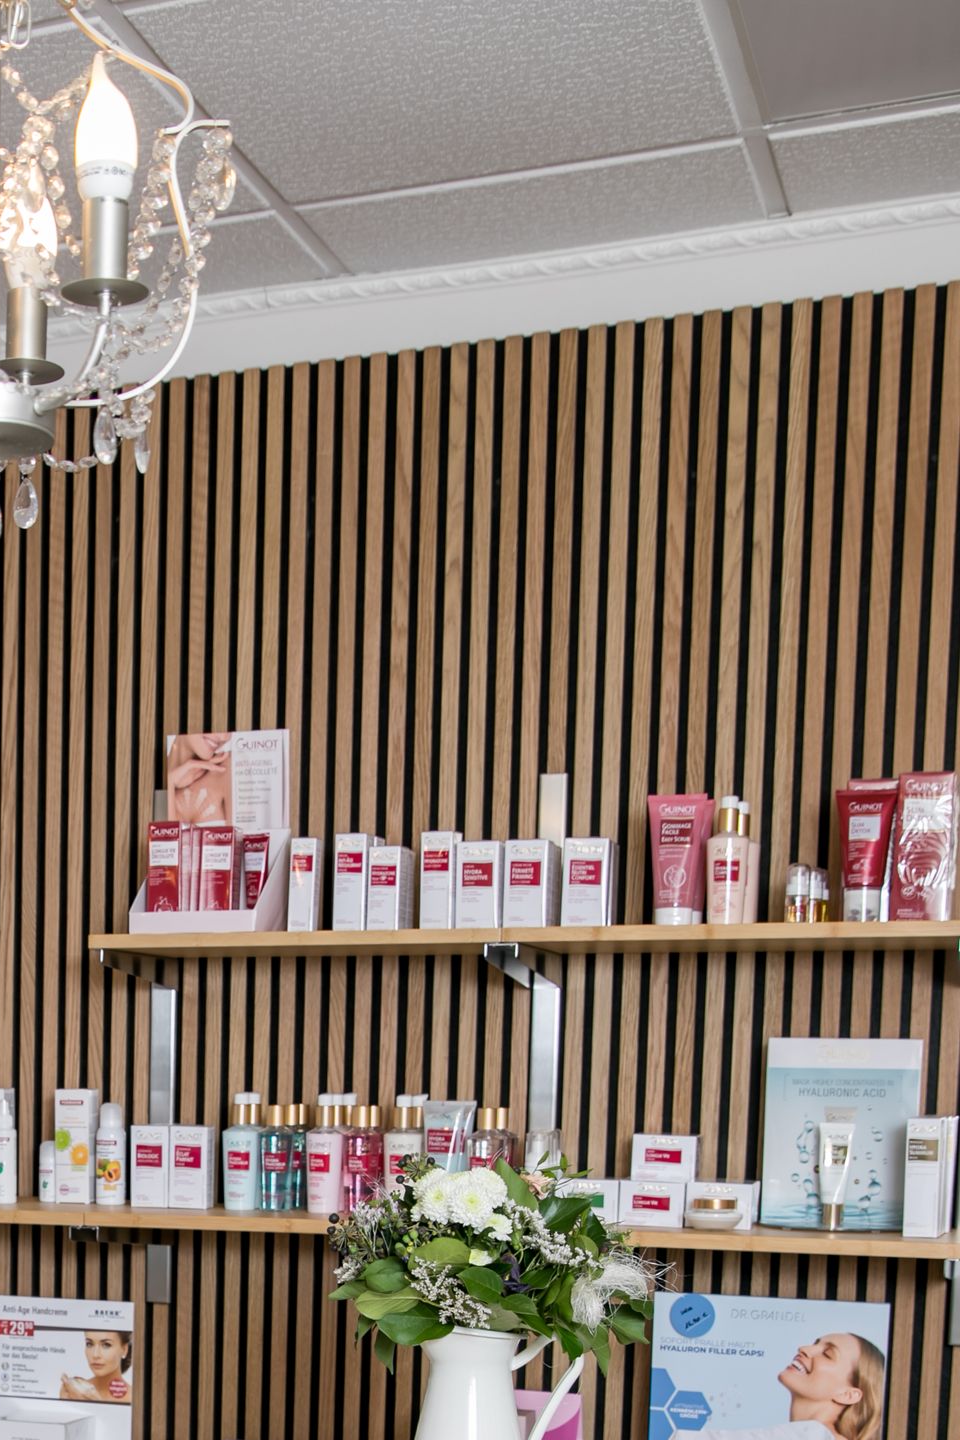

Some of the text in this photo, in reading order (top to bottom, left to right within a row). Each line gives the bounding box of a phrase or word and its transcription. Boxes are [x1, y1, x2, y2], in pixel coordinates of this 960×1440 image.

[237, 738, 279, 750] GUINOT
[659, 803, 696, 813] GUINOT
[848, 802, 883, 811] GUINOT
[150, 826, 179, 837] GUINOT
[204, 831, 232, 841] GUINOT
[798, 1088, 887, 1098] HYALURONIC ACID
[32, 1306, 68, 1316] Handcreme
[694, 1338, 727, 1347] PRALLE
[659, 1344, 765, 1357] HYALURON FILLER CAPS!
